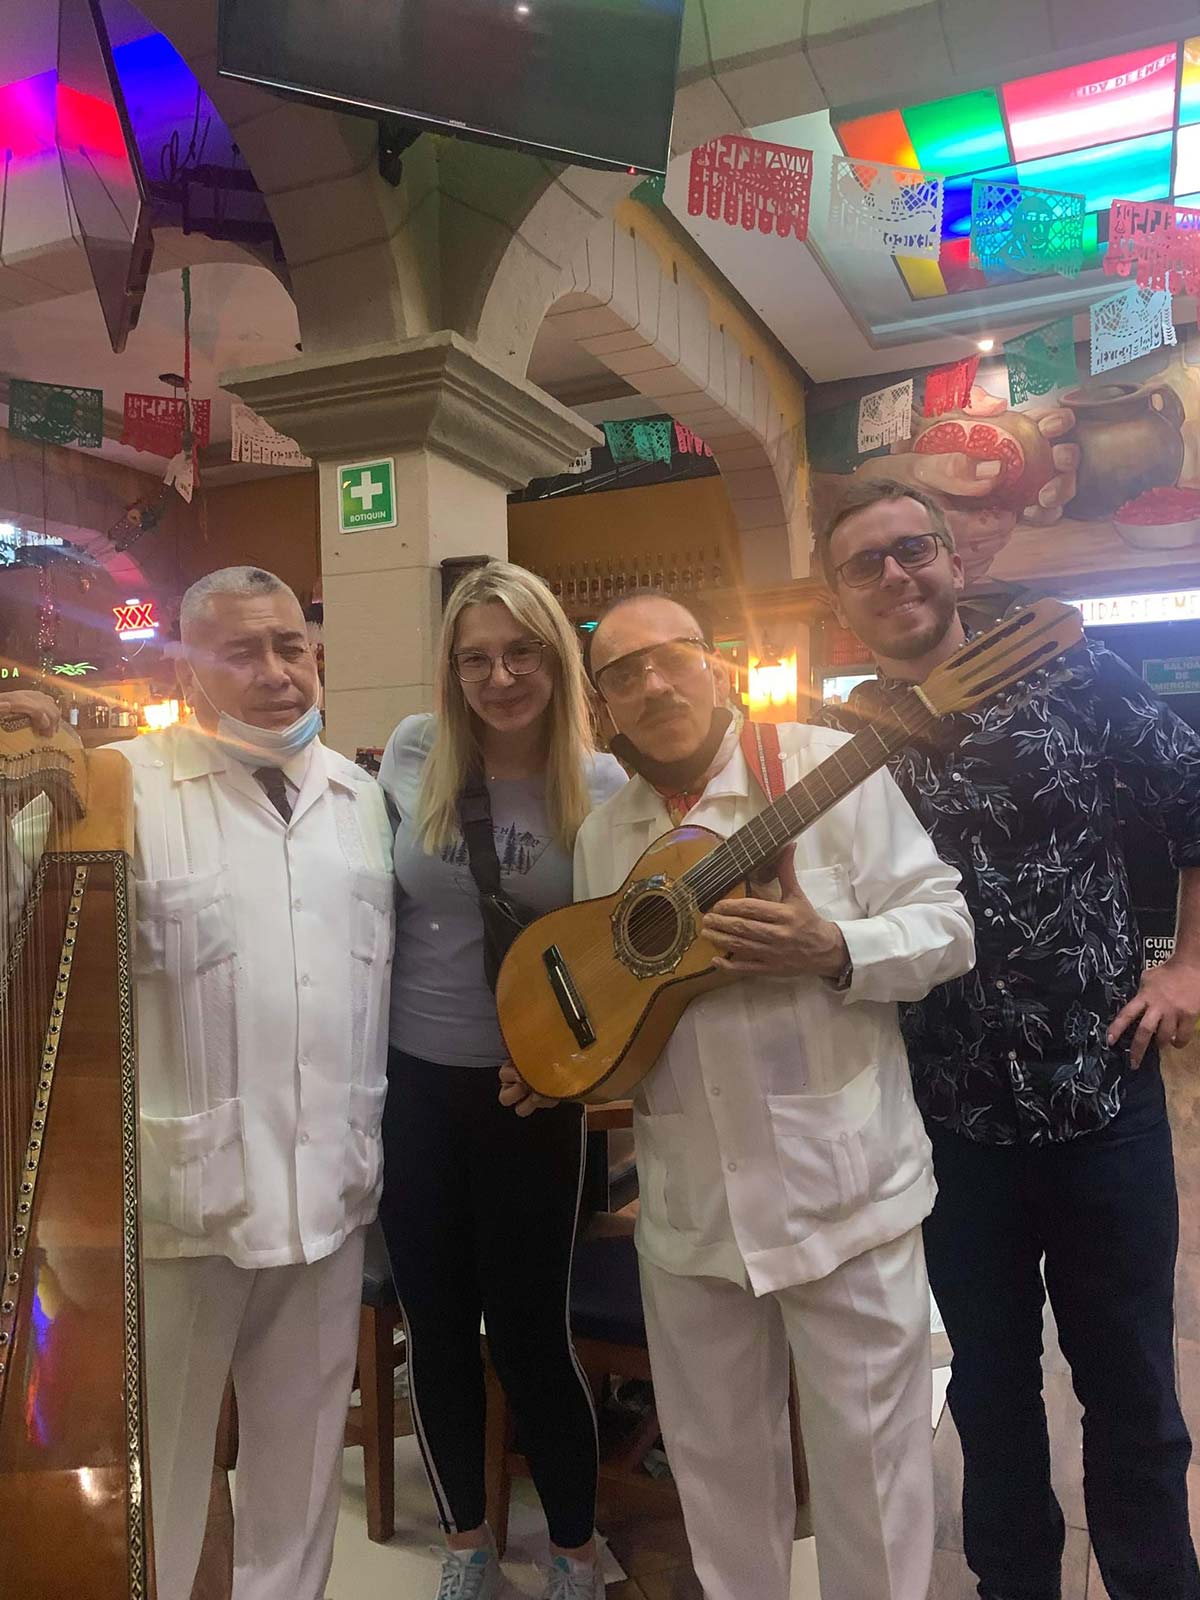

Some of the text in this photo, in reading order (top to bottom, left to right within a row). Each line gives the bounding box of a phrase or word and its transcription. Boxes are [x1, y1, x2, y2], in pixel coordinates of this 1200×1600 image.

[350, 510, 386, 522] BOTIQUIN
[1080, 601, 1120, 621] LIDA
[1145, 938, 1175, 949] CUID
